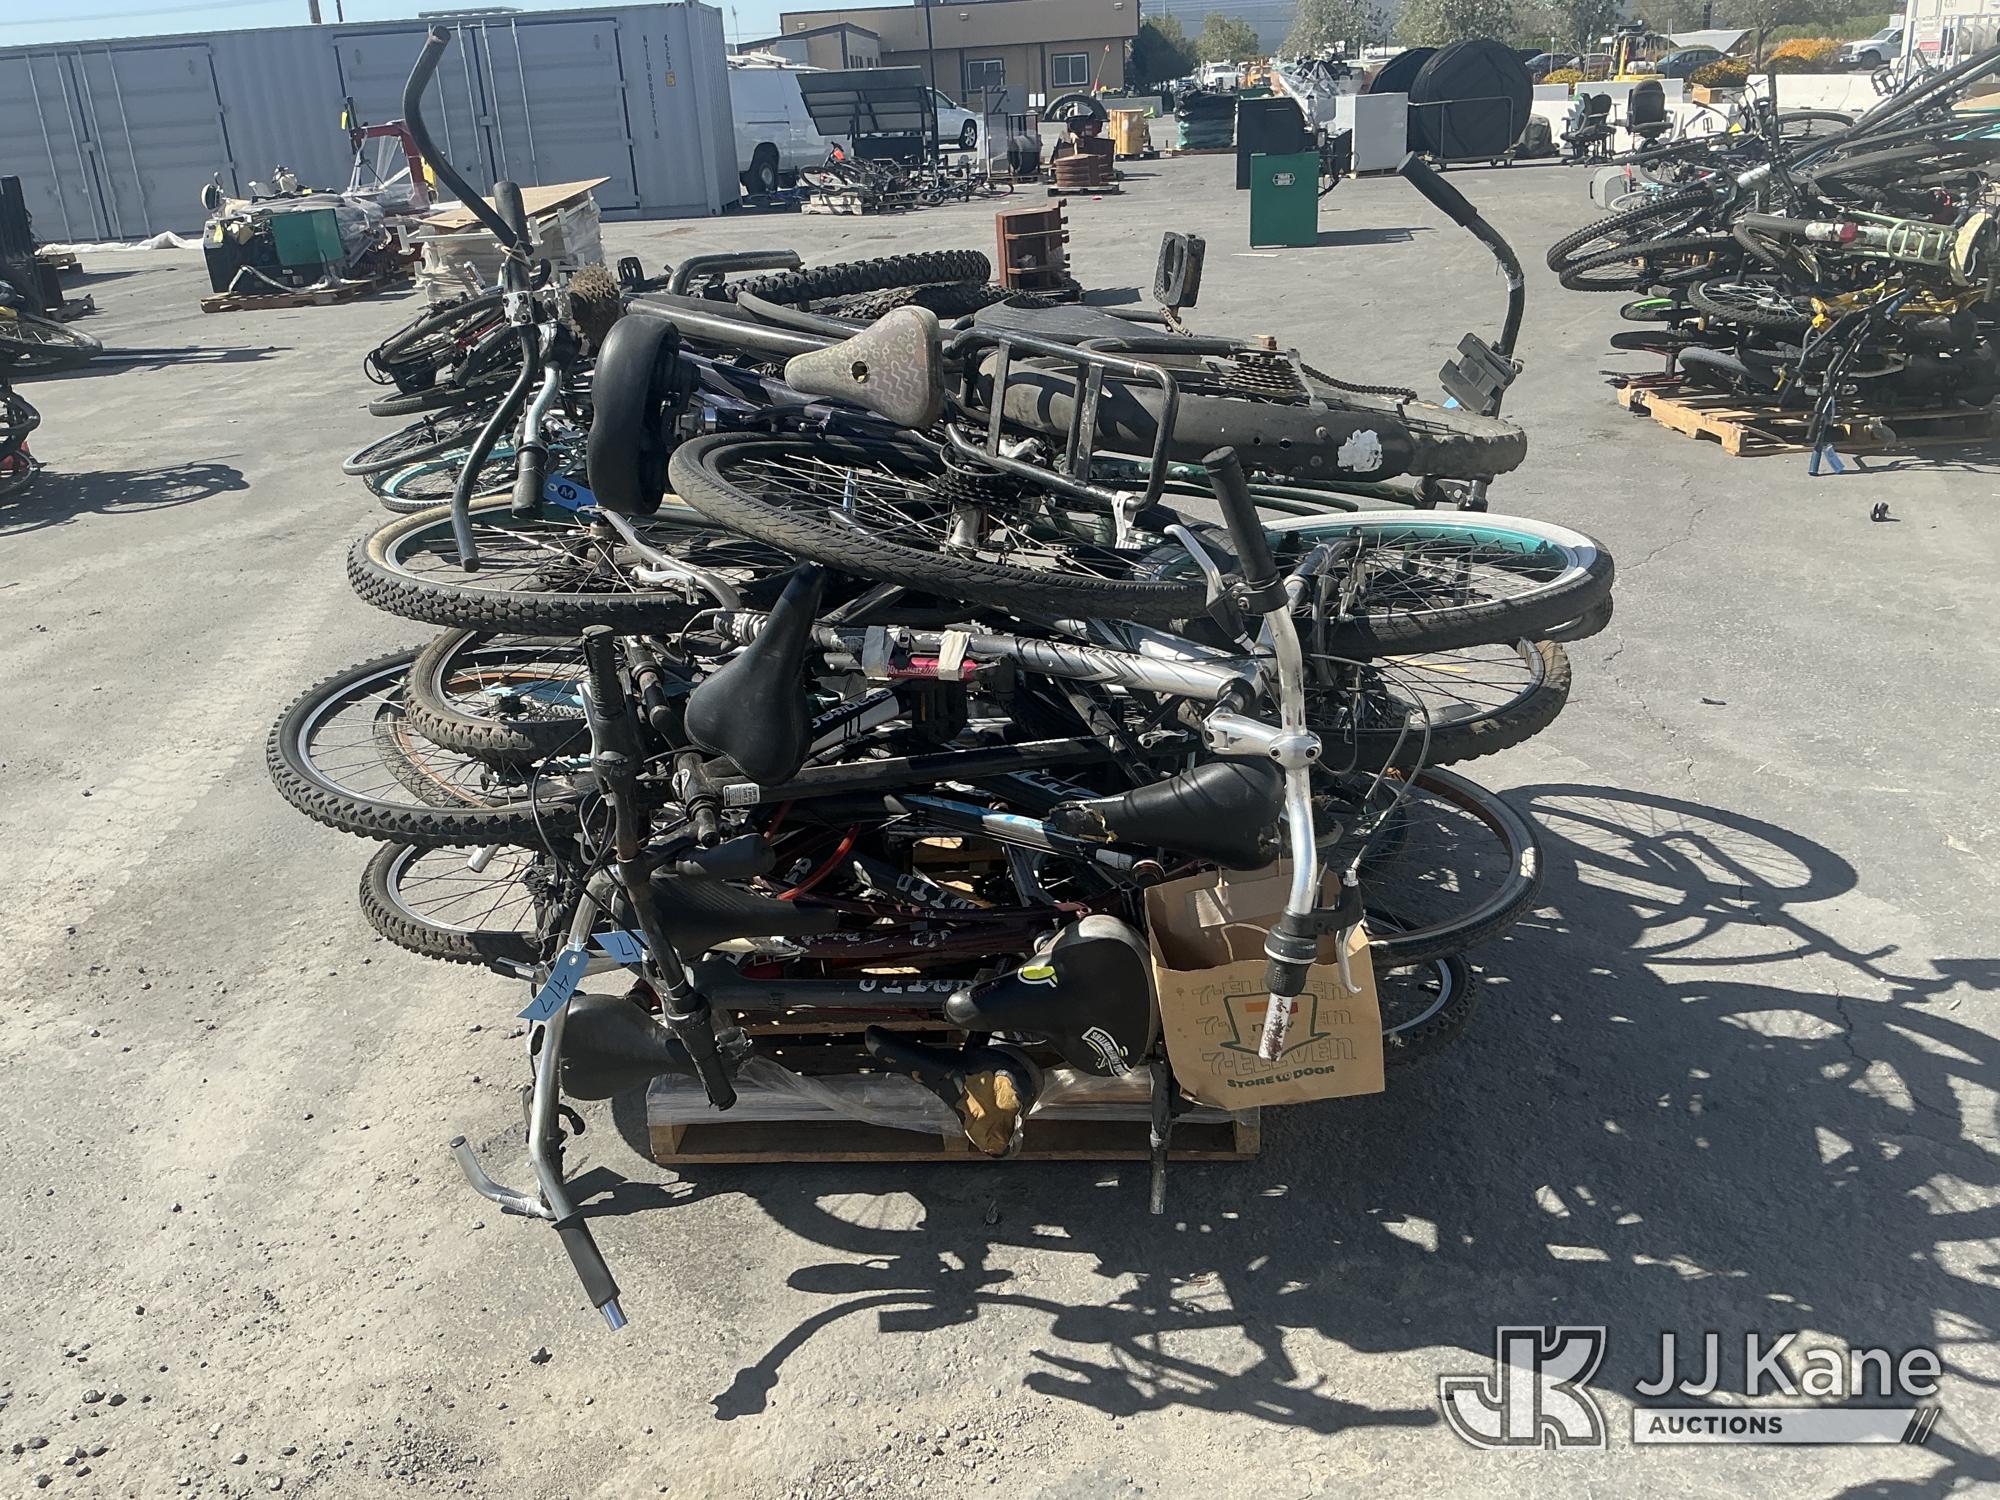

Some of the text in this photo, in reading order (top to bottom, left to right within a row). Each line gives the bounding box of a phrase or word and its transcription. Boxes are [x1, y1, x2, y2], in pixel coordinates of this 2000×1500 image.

[560, 486, 575, 499] M
[539, 974, 569, 1014] 417
[1226, 1076, 1275, 1089] STORE
[1293, 1065, 1336, 1080] DOOR
